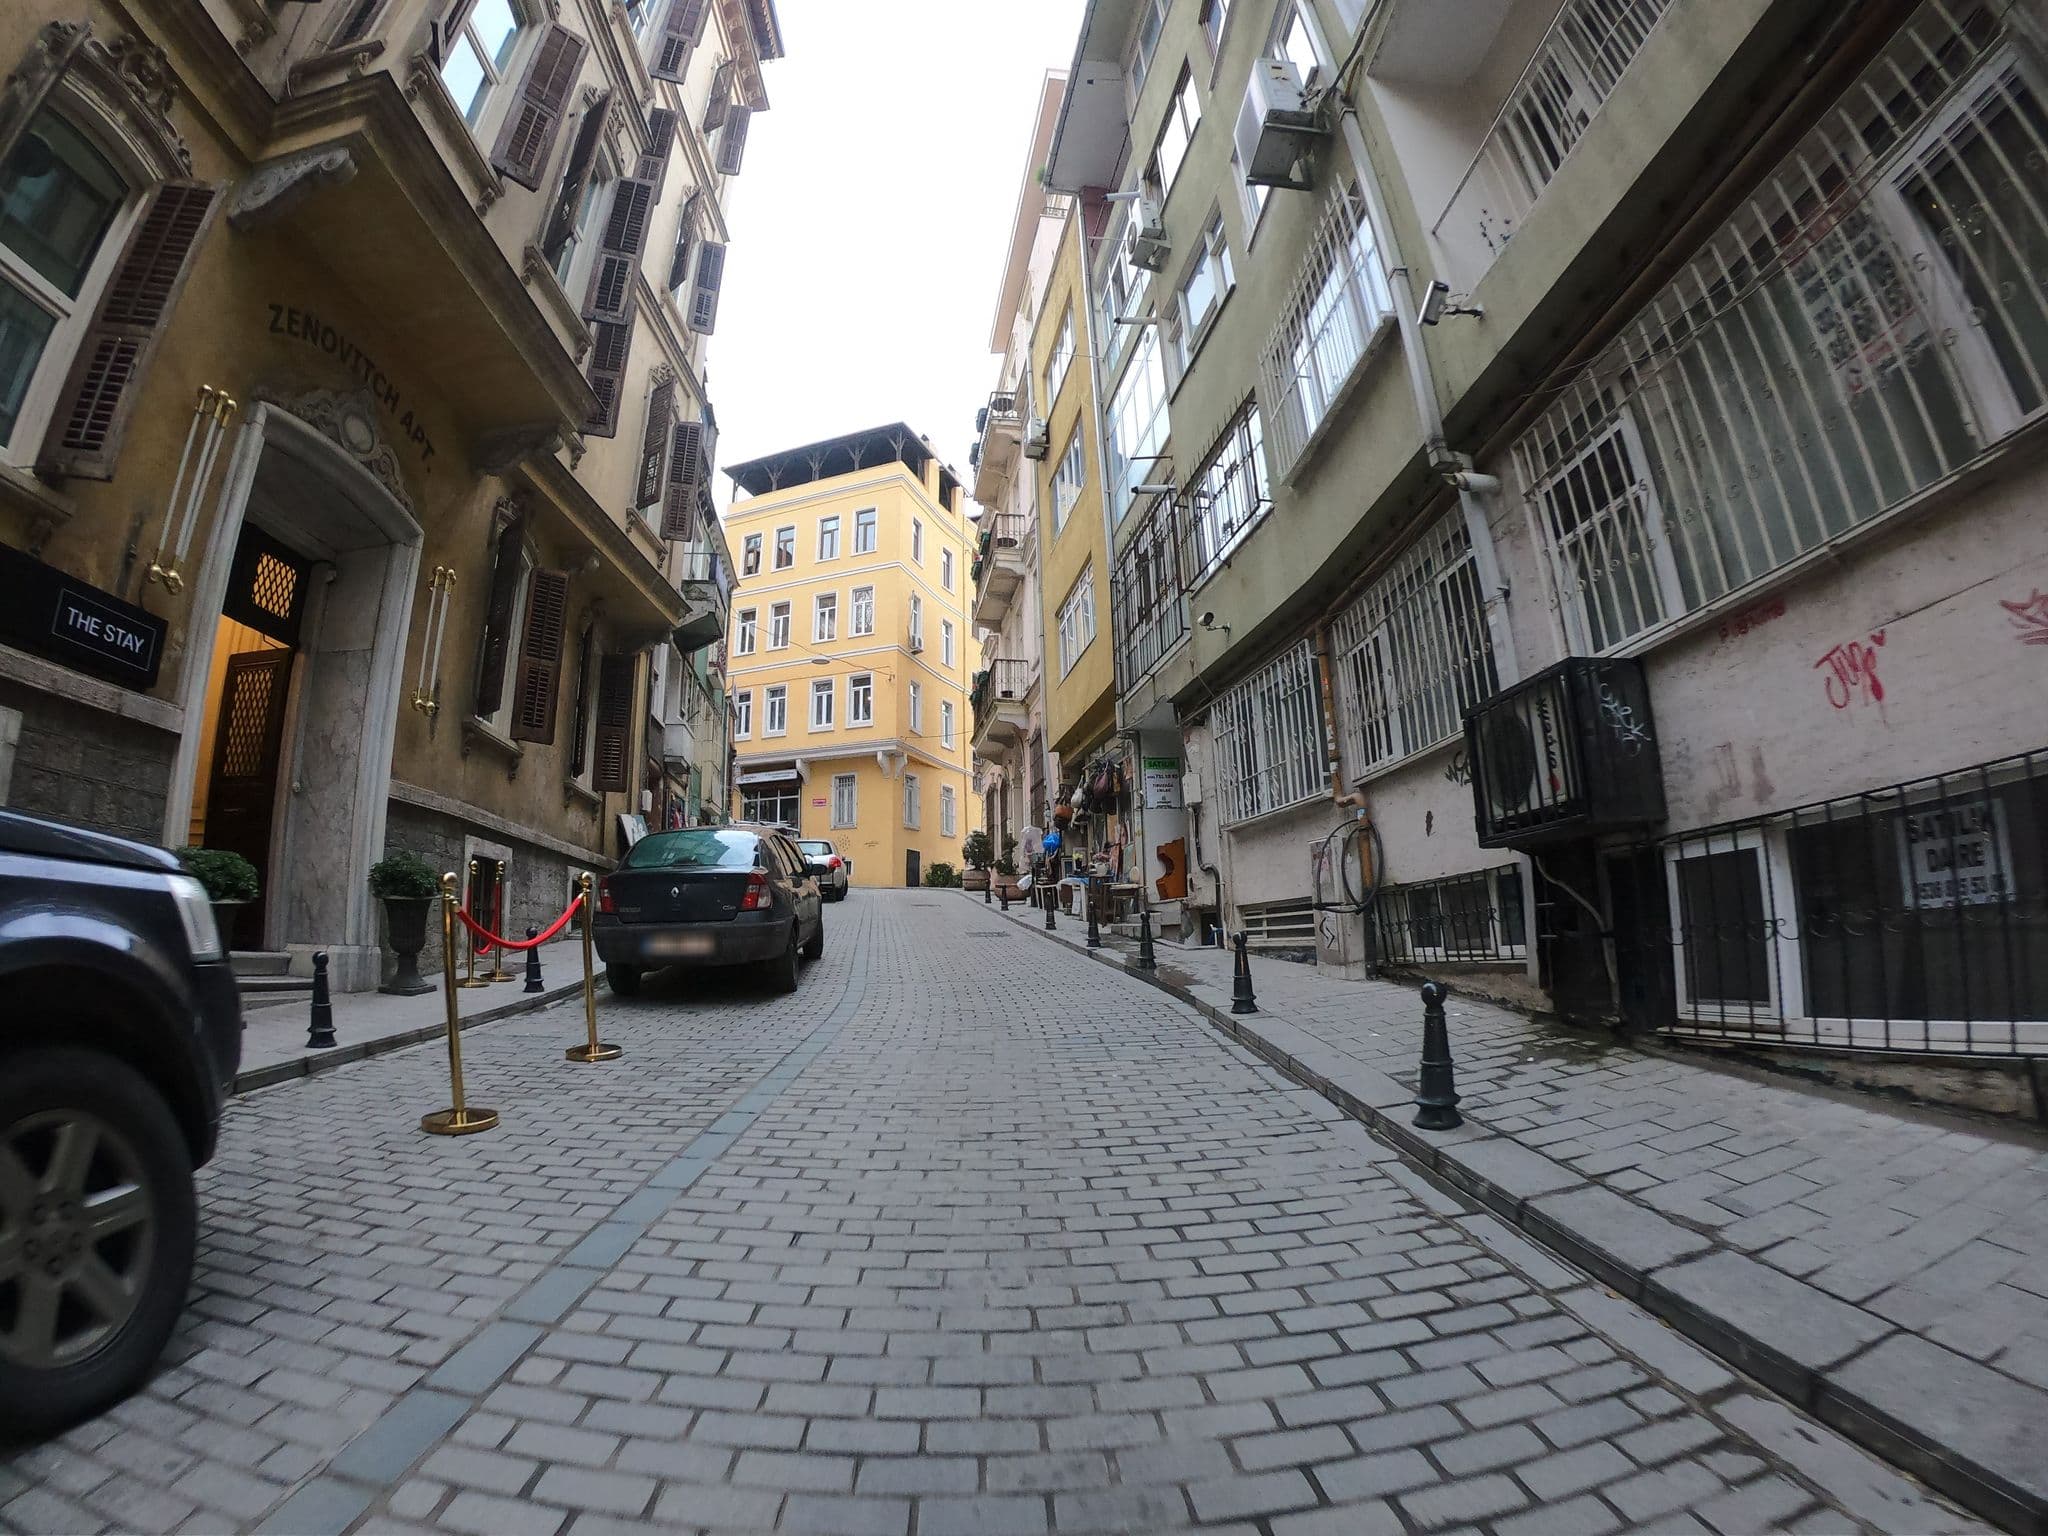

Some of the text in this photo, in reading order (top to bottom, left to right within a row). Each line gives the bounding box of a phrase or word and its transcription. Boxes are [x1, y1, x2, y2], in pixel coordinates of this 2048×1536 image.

[268, 303, 435, 473] ZENOVITCH APT.
[67, 606, 145, 654] THE STAY
